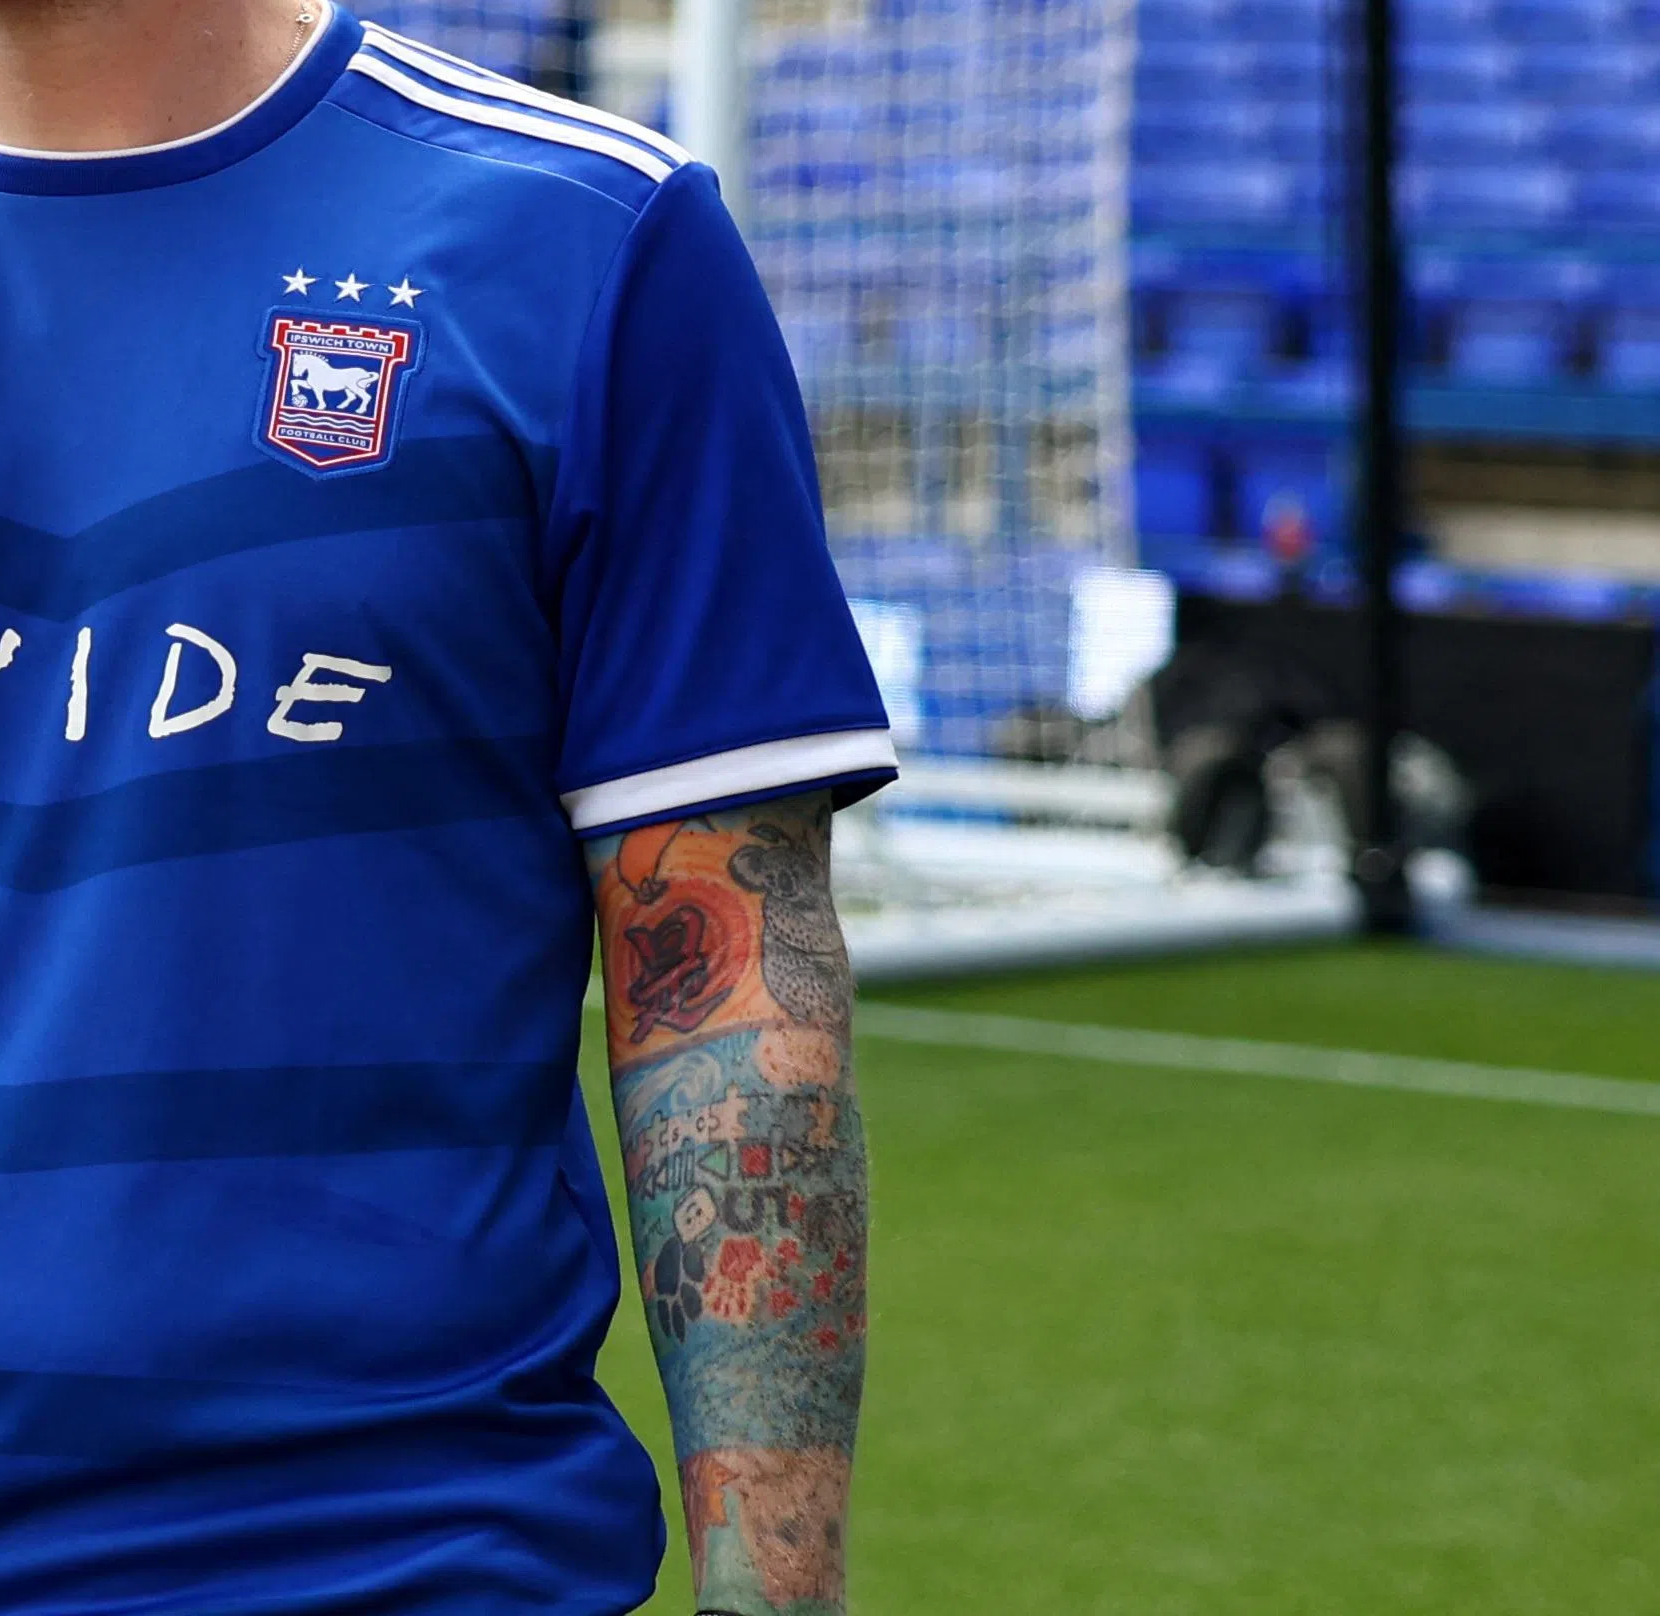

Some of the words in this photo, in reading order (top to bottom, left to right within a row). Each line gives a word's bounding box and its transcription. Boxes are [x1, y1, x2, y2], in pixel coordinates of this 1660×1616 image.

[289, 333, 344, 349] IPSWICH
[346, 338, 390, 354] TOWN
[280, 427, 336, 443] FOOTBALL
[337, 435, 368, 448] CLUB
